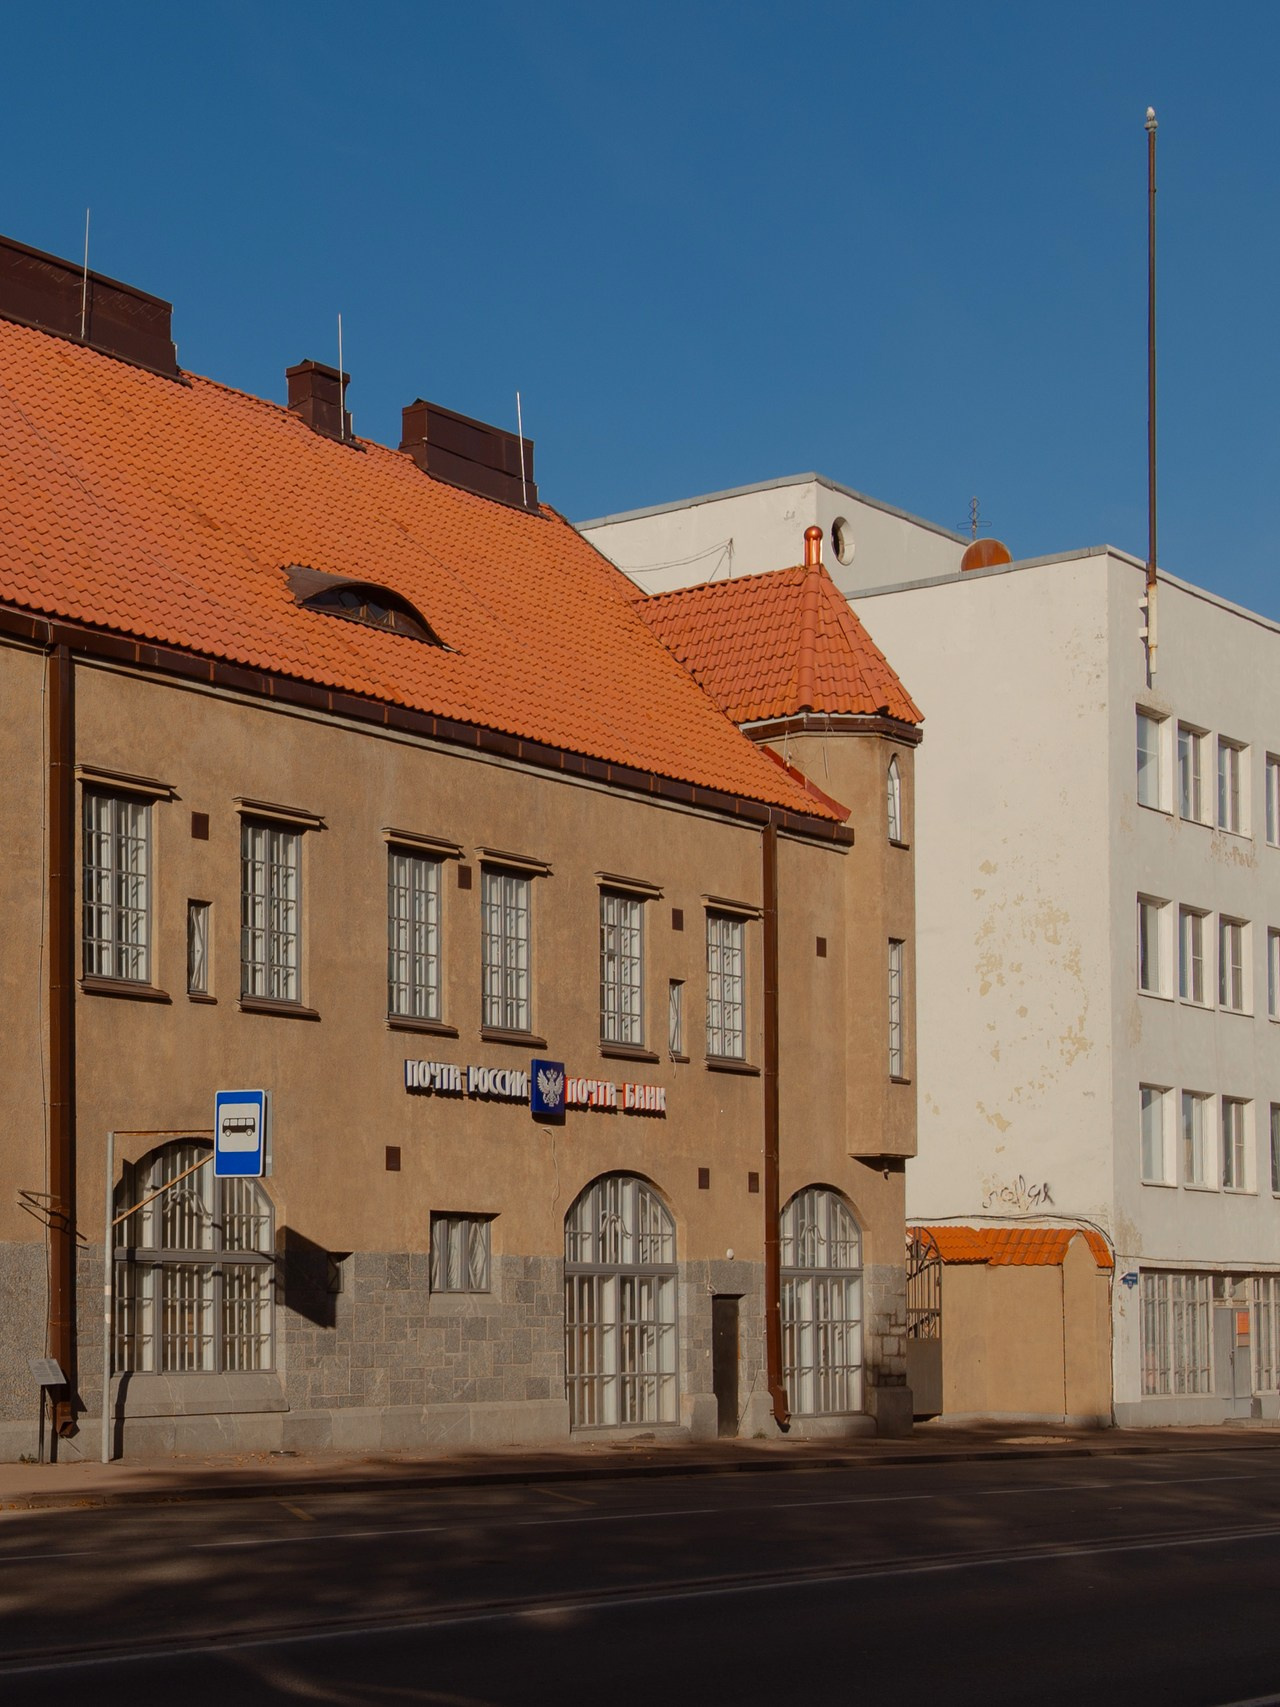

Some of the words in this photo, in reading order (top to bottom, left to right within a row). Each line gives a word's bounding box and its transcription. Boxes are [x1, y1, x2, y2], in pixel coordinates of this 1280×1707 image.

[405, 1060, 462, 1091] ПОЧТА
[467, 1066, 528, 1097] РОССИИ
[566, 1077, 617, 1107] ПОЧТА
[624, 1083, 666, 1111] БАНК
